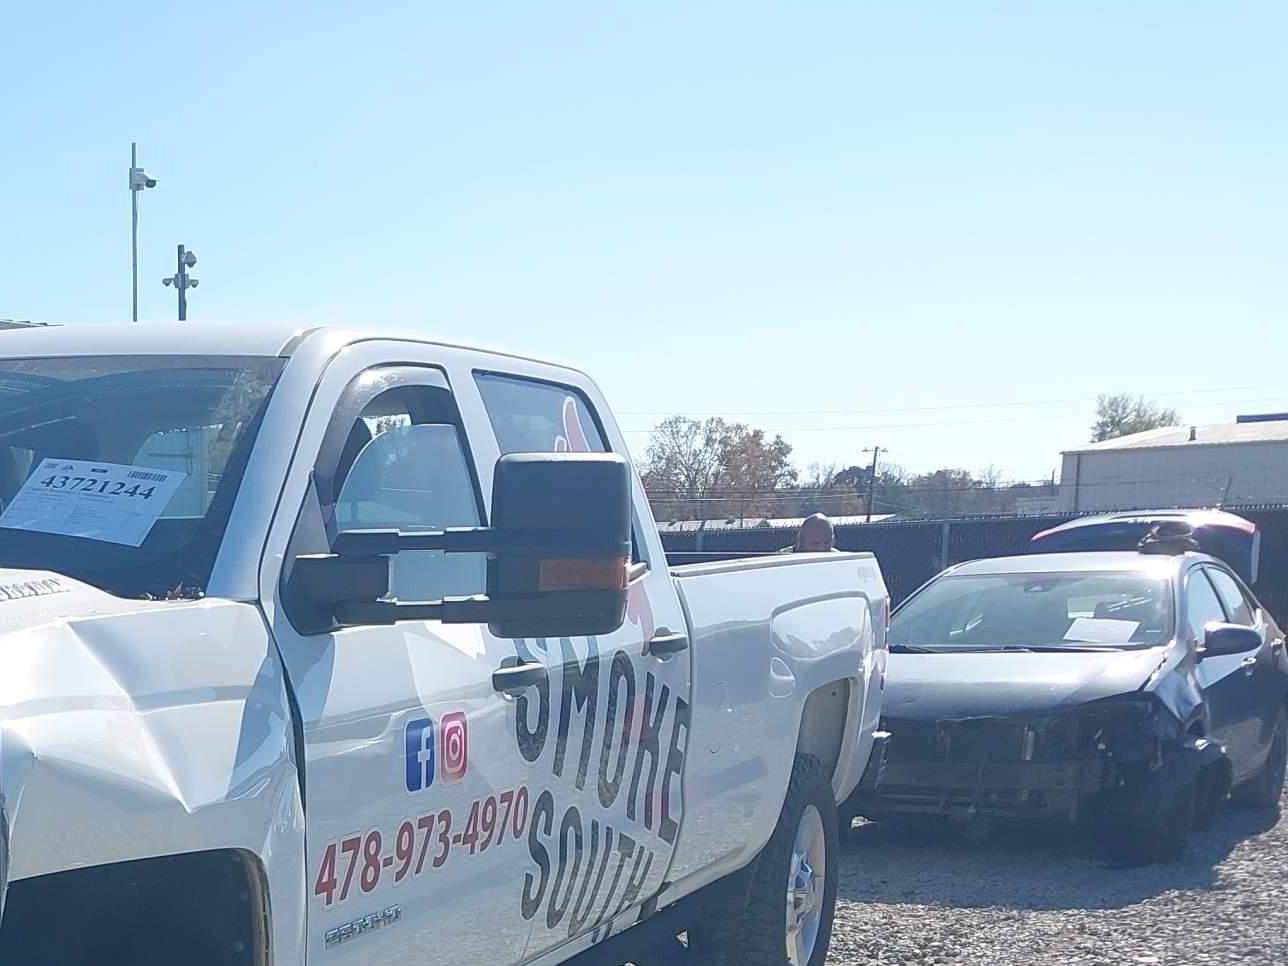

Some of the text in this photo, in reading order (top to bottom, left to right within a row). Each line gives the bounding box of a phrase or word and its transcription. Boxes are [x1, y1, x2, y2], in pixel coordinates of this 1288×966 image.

[40, 474, 156, 500] 43721244
[513, 635, 692, 847] SMOKE
[314, 785, 529, 906] 478-973-4970
[521, 789, 655, 942] SOUTH
